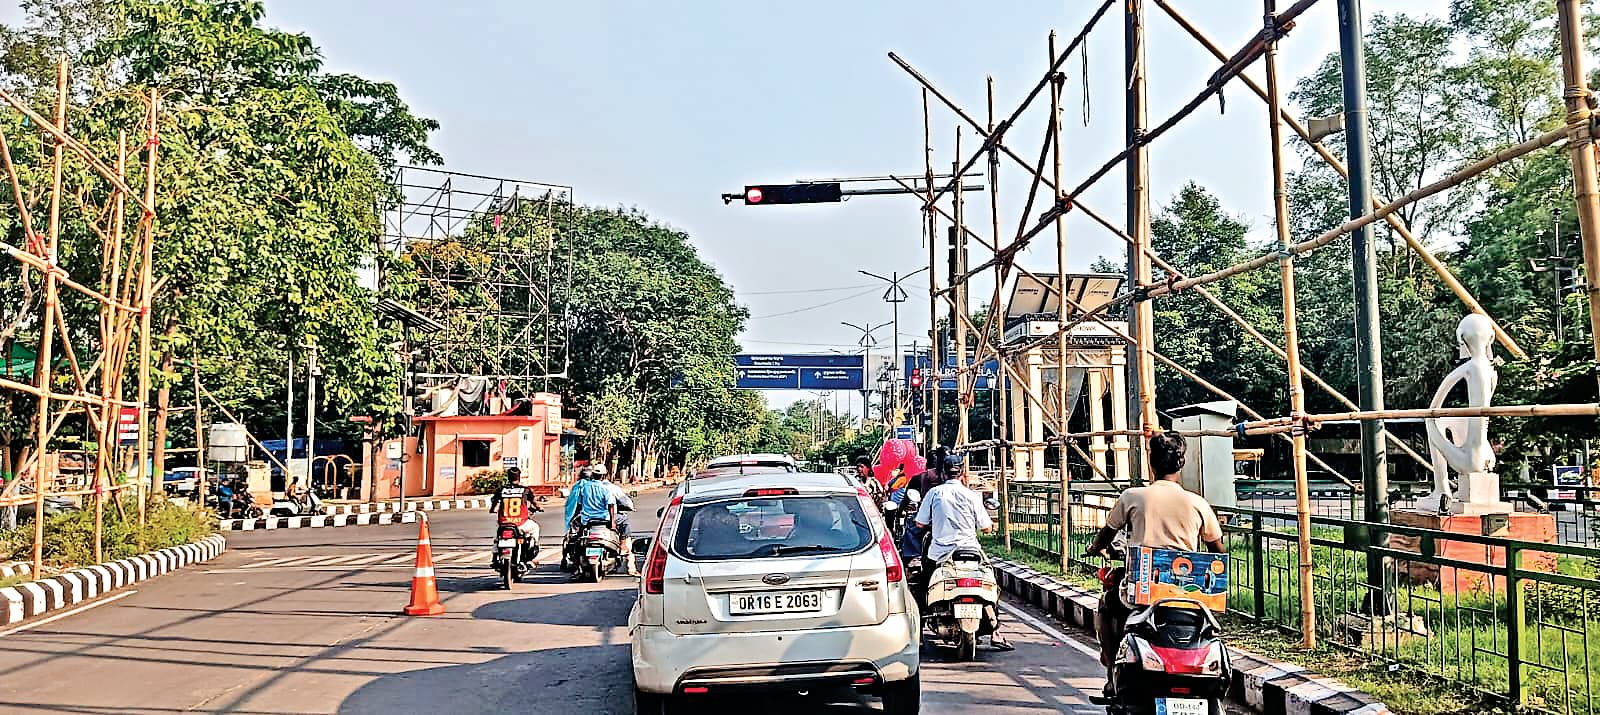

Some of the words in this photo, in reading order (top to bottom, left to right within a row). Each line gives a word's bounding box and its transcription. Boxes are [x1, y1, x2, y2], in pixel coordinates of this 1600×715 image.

[503, 497, 522, 517] 18
[739, 595, 772, 610] OR16
[774, 595, 783, 609] E
[786, 593, 819, 608] 2063
